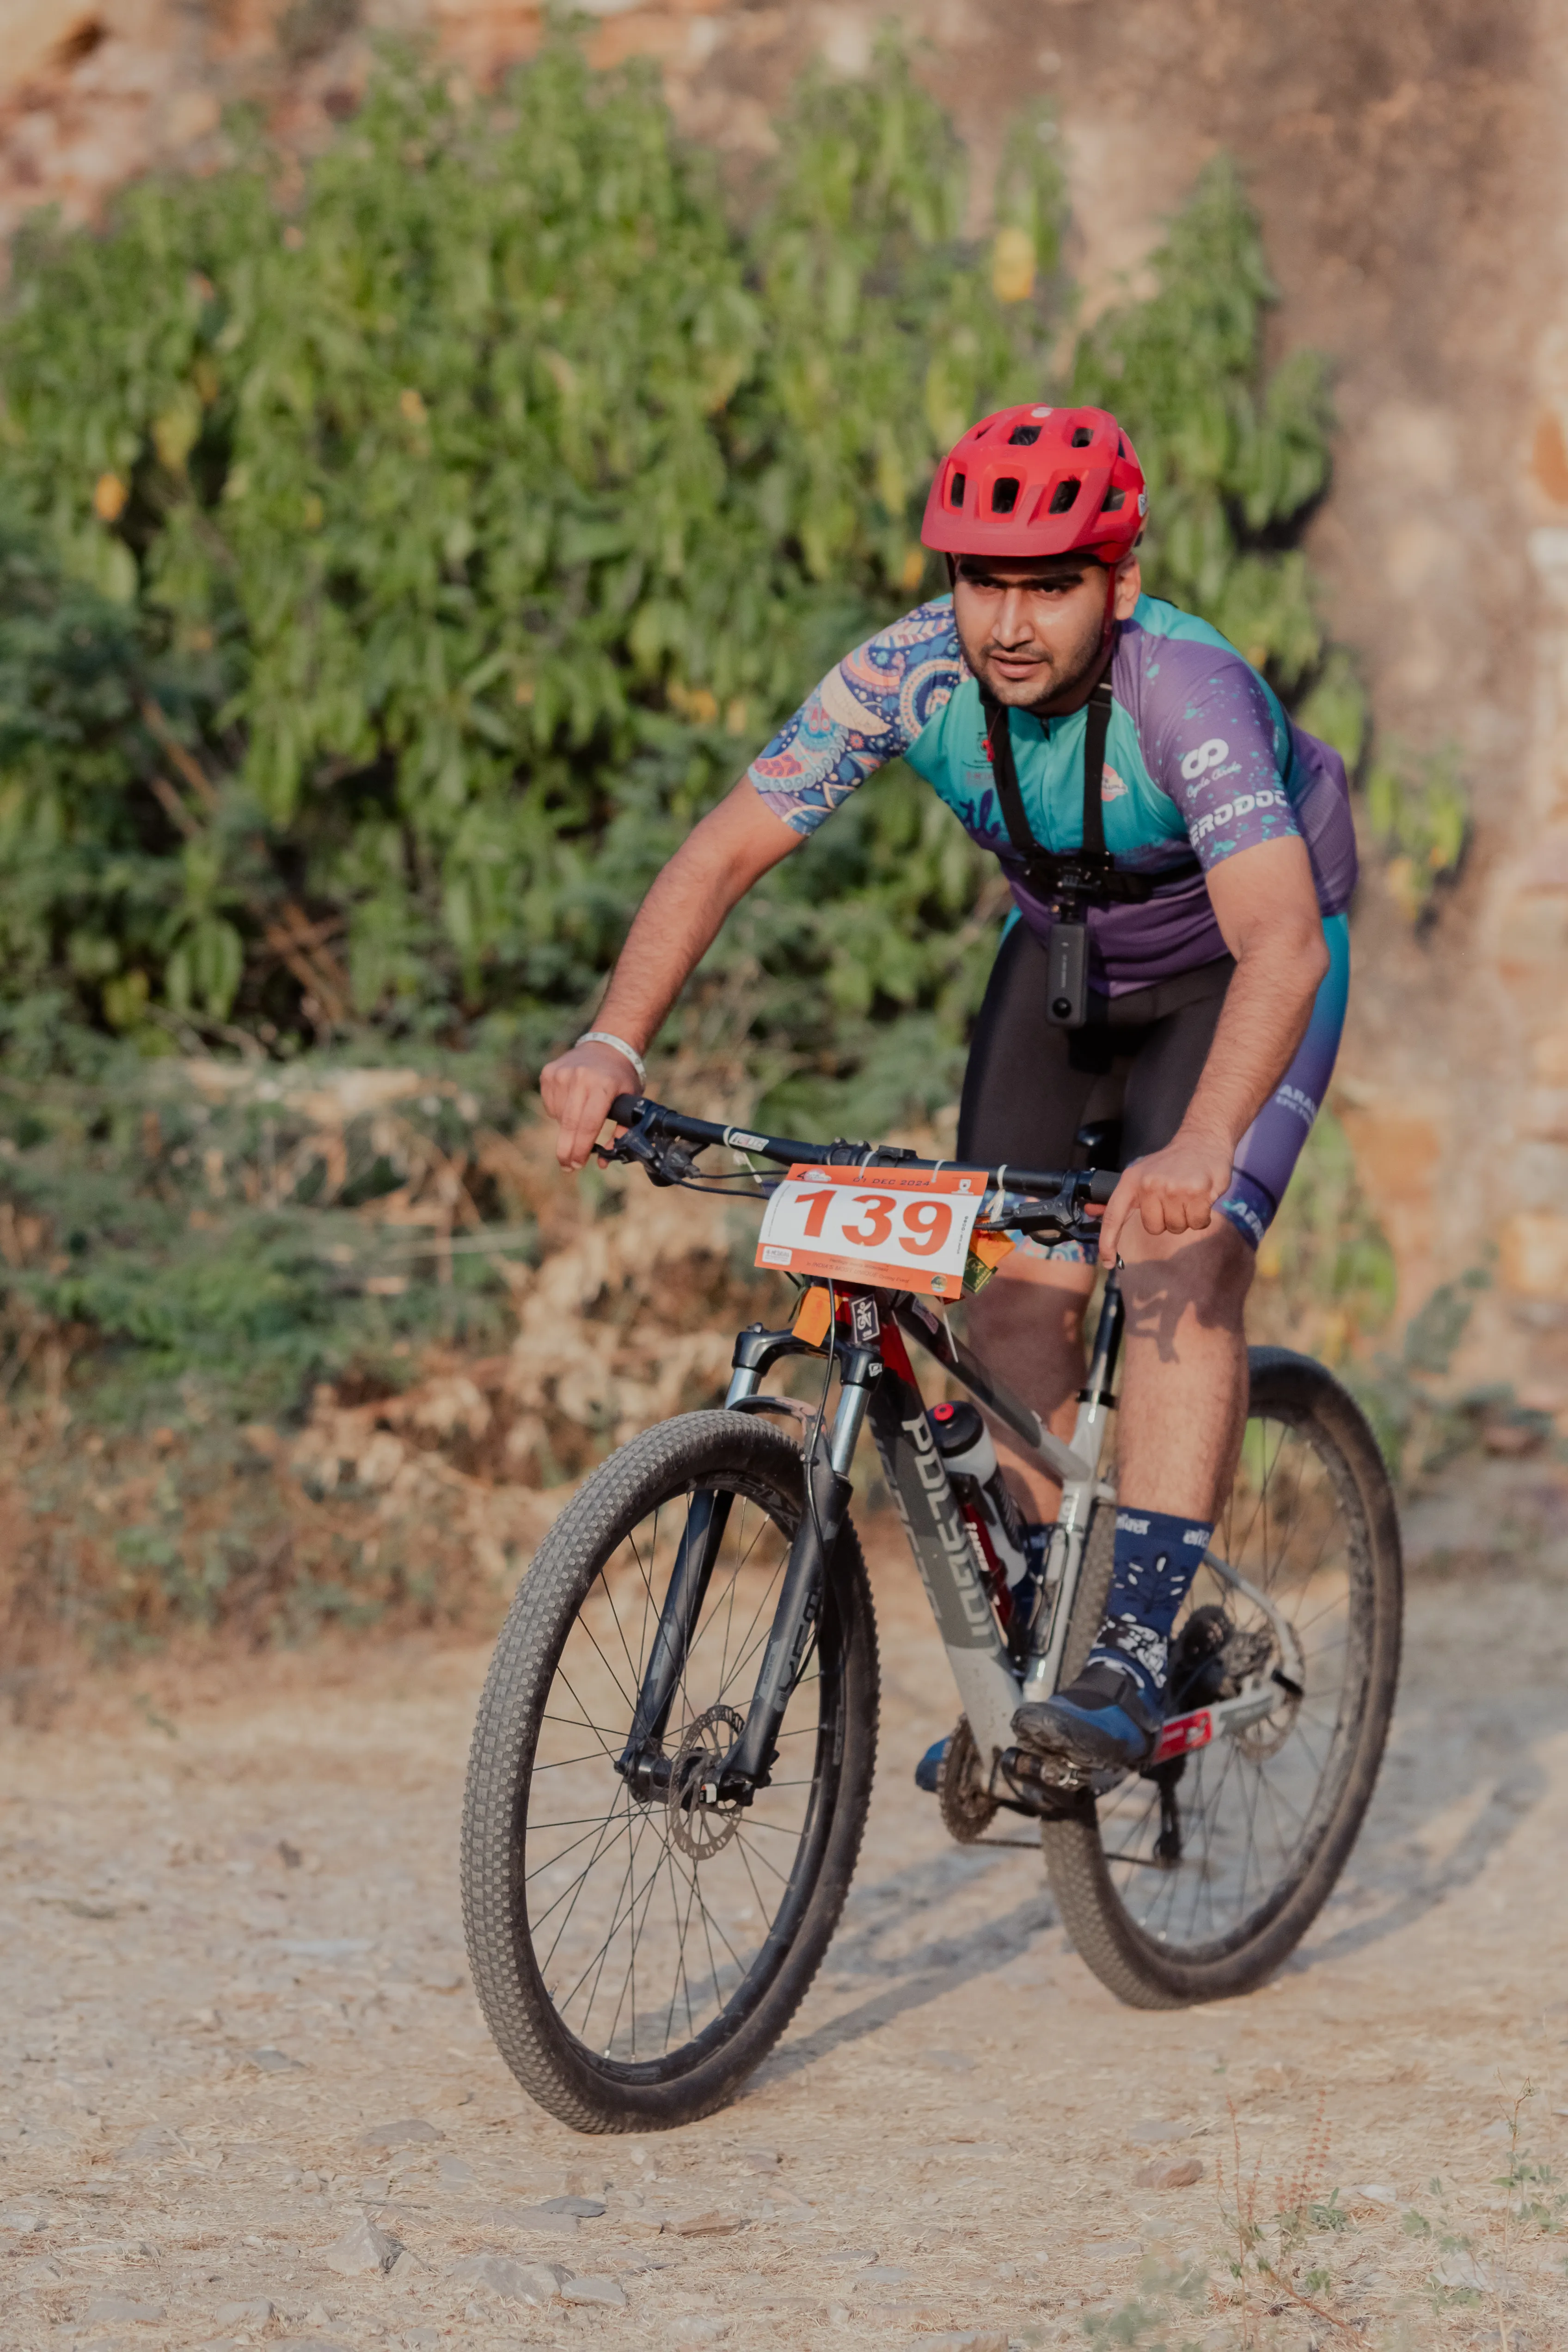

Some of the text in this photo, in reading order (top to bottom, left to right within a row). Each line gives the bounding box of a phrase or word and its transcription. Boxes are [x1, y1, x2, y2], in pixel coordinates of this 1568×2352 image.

[793, 1189, 953, 1256] 139
[854, 1269, 878, 1278] UNIQUE
[901, 1411, 1002, 1656] POLYGON
